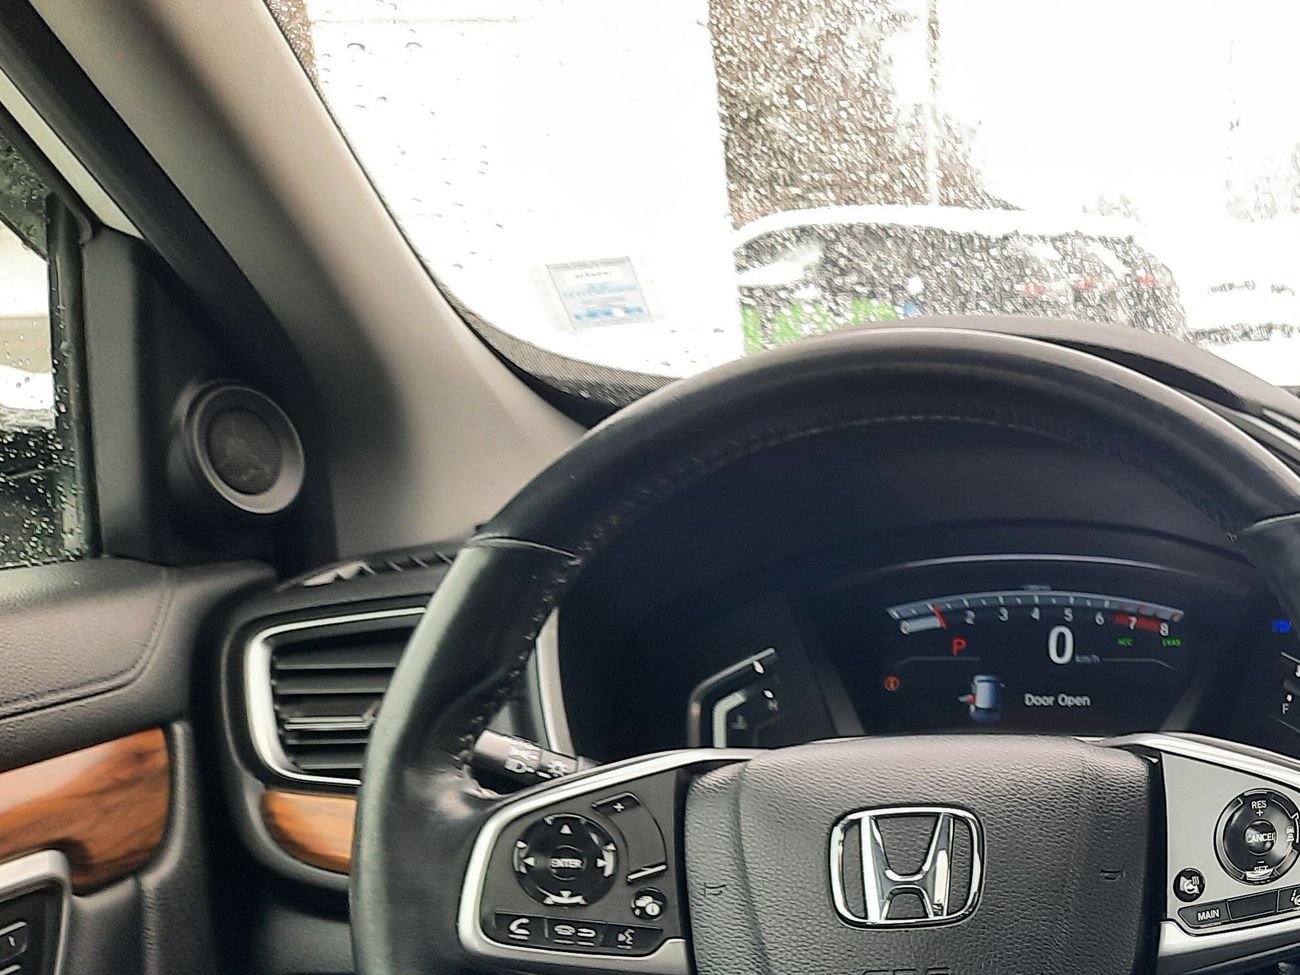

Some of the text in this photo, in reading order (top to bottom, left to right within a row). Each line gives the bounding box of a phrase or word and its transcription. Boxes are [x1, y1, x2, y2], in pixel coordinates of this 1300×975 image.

[964, 609, 976, 625] 2
[999, 606, 1009, 622] 3
[1030, 606, 1041, 621] 4
[1063, 606, 1074, 622] 5
[1095, 612, 1105, 625] 6
[1127, 615, 1138, 630] 7
[1159, 622, 1169, 637] 8
[952, 636, 967, 656] P
[1048, 625, 1074, 665] 0
[1024, 692, 1091, 708] Door Open
[1281, 703, 1289, 714] F
[1251, 801, 1267, 809] RES
[1246, 833, 1275, 843] CANCEL
[551, 858, 582, 868] ENTER
[1197, 909, 1220, 921] MAIN
